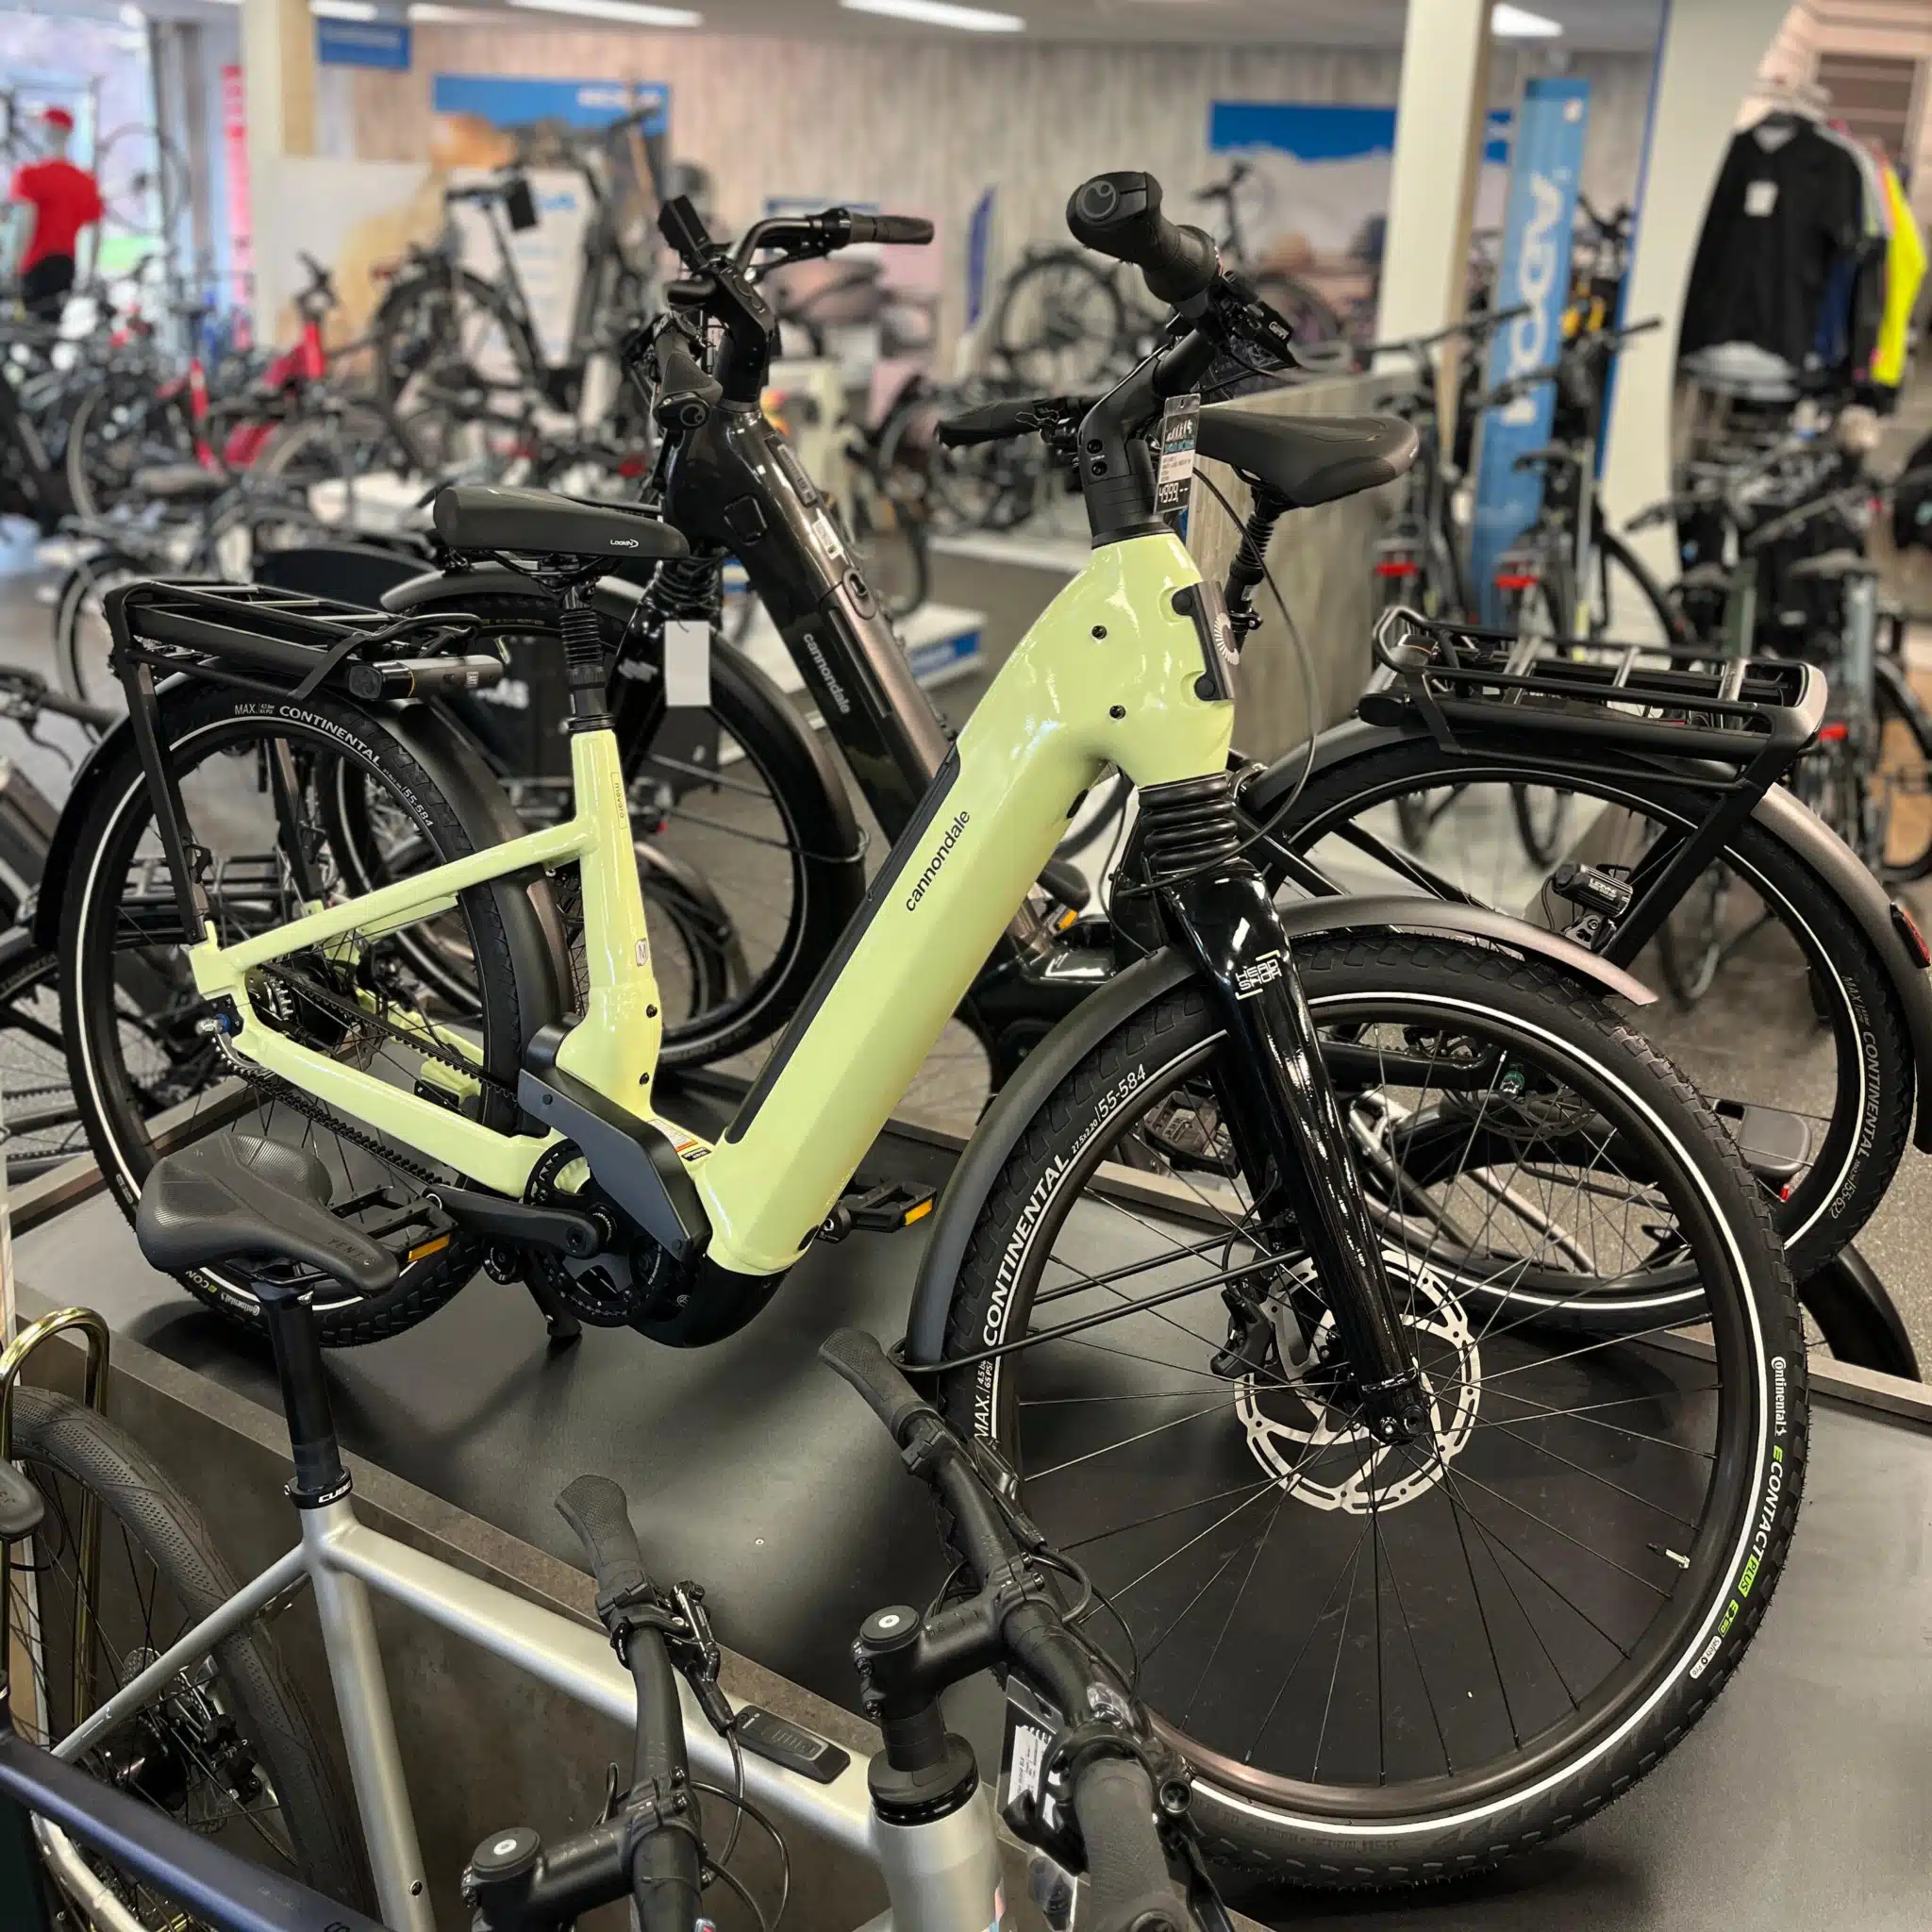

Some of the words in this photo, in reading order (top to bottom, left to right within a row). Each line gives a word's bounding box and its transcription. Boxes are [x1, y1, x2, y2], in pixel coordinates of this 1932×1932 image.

[803, 633, 851, 715] cannondale
[279, 705, 380, 768] CONTINENTAL
[615, 782, 625, 819] mavaro
[906, 810, 970, 911] cannondale
[638, 944, 648, 961] M
[1235, 958, 1279, 982] HEAD
[1858, 1030, 1881, 1158] CONTINENTAL
[982, 1154, 1070, 1347] CONTINENTAL
[1770, 1356, 1788, 1427] Continental
